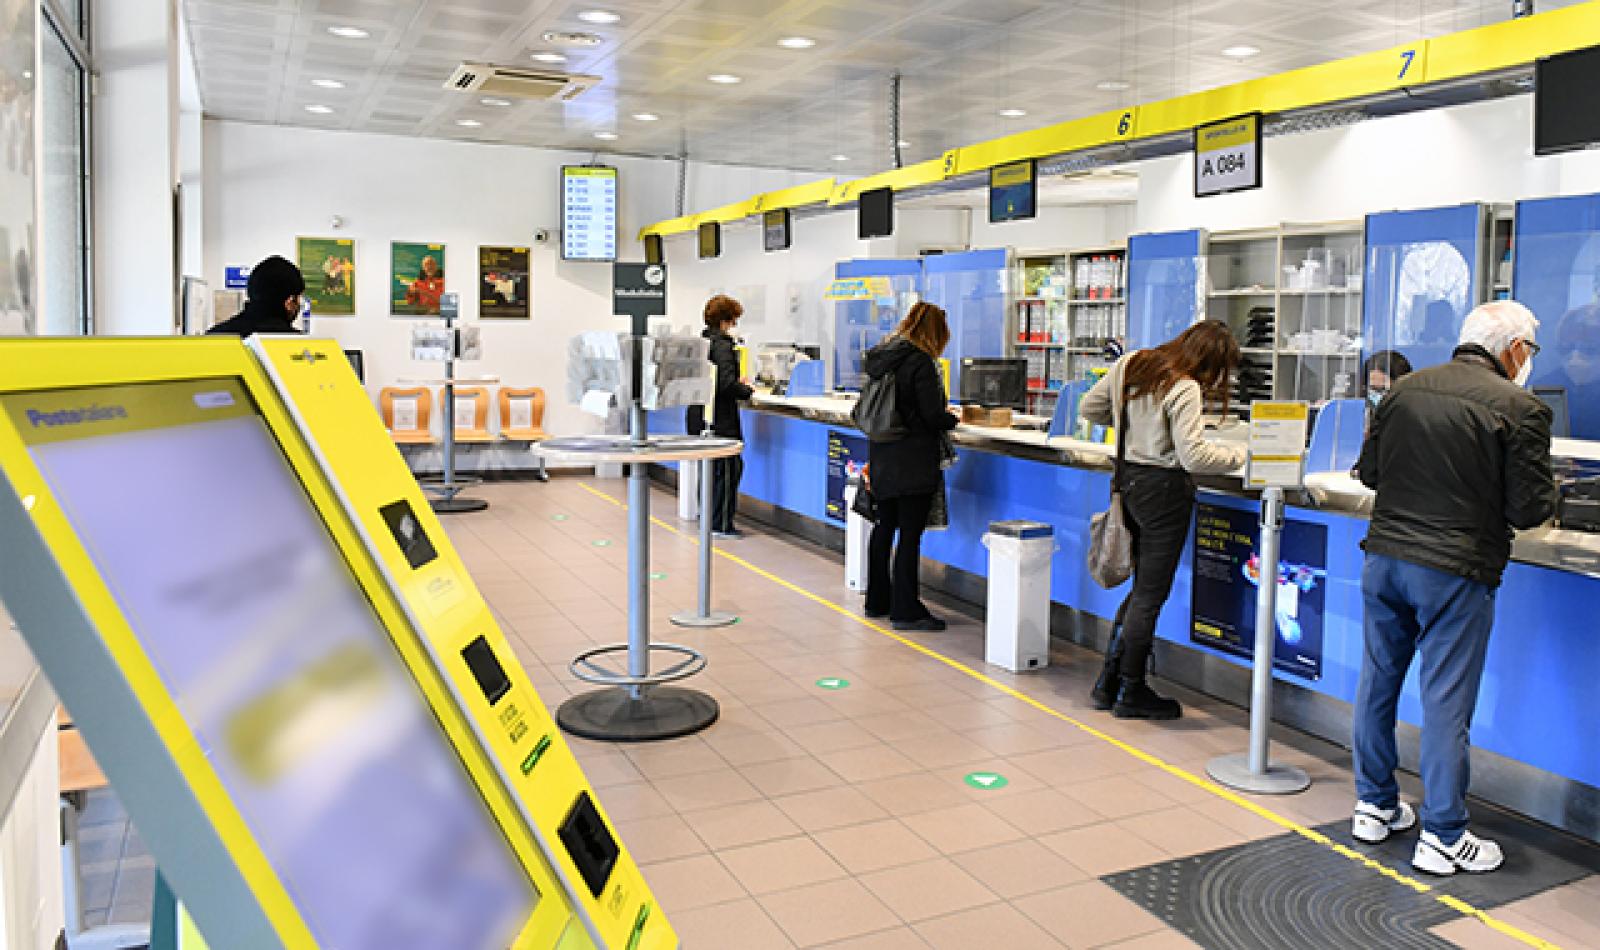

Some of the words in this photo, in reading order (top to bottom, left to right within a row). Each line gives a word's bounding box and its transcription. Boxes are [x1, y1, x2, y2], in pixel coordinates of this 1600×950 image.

[1398, 50, 1416, 79] 7
[1117, 112, 1131, 135] 6
[1202, 159, 1215, 177] A
[1217, 152, 1246, 175] 084
